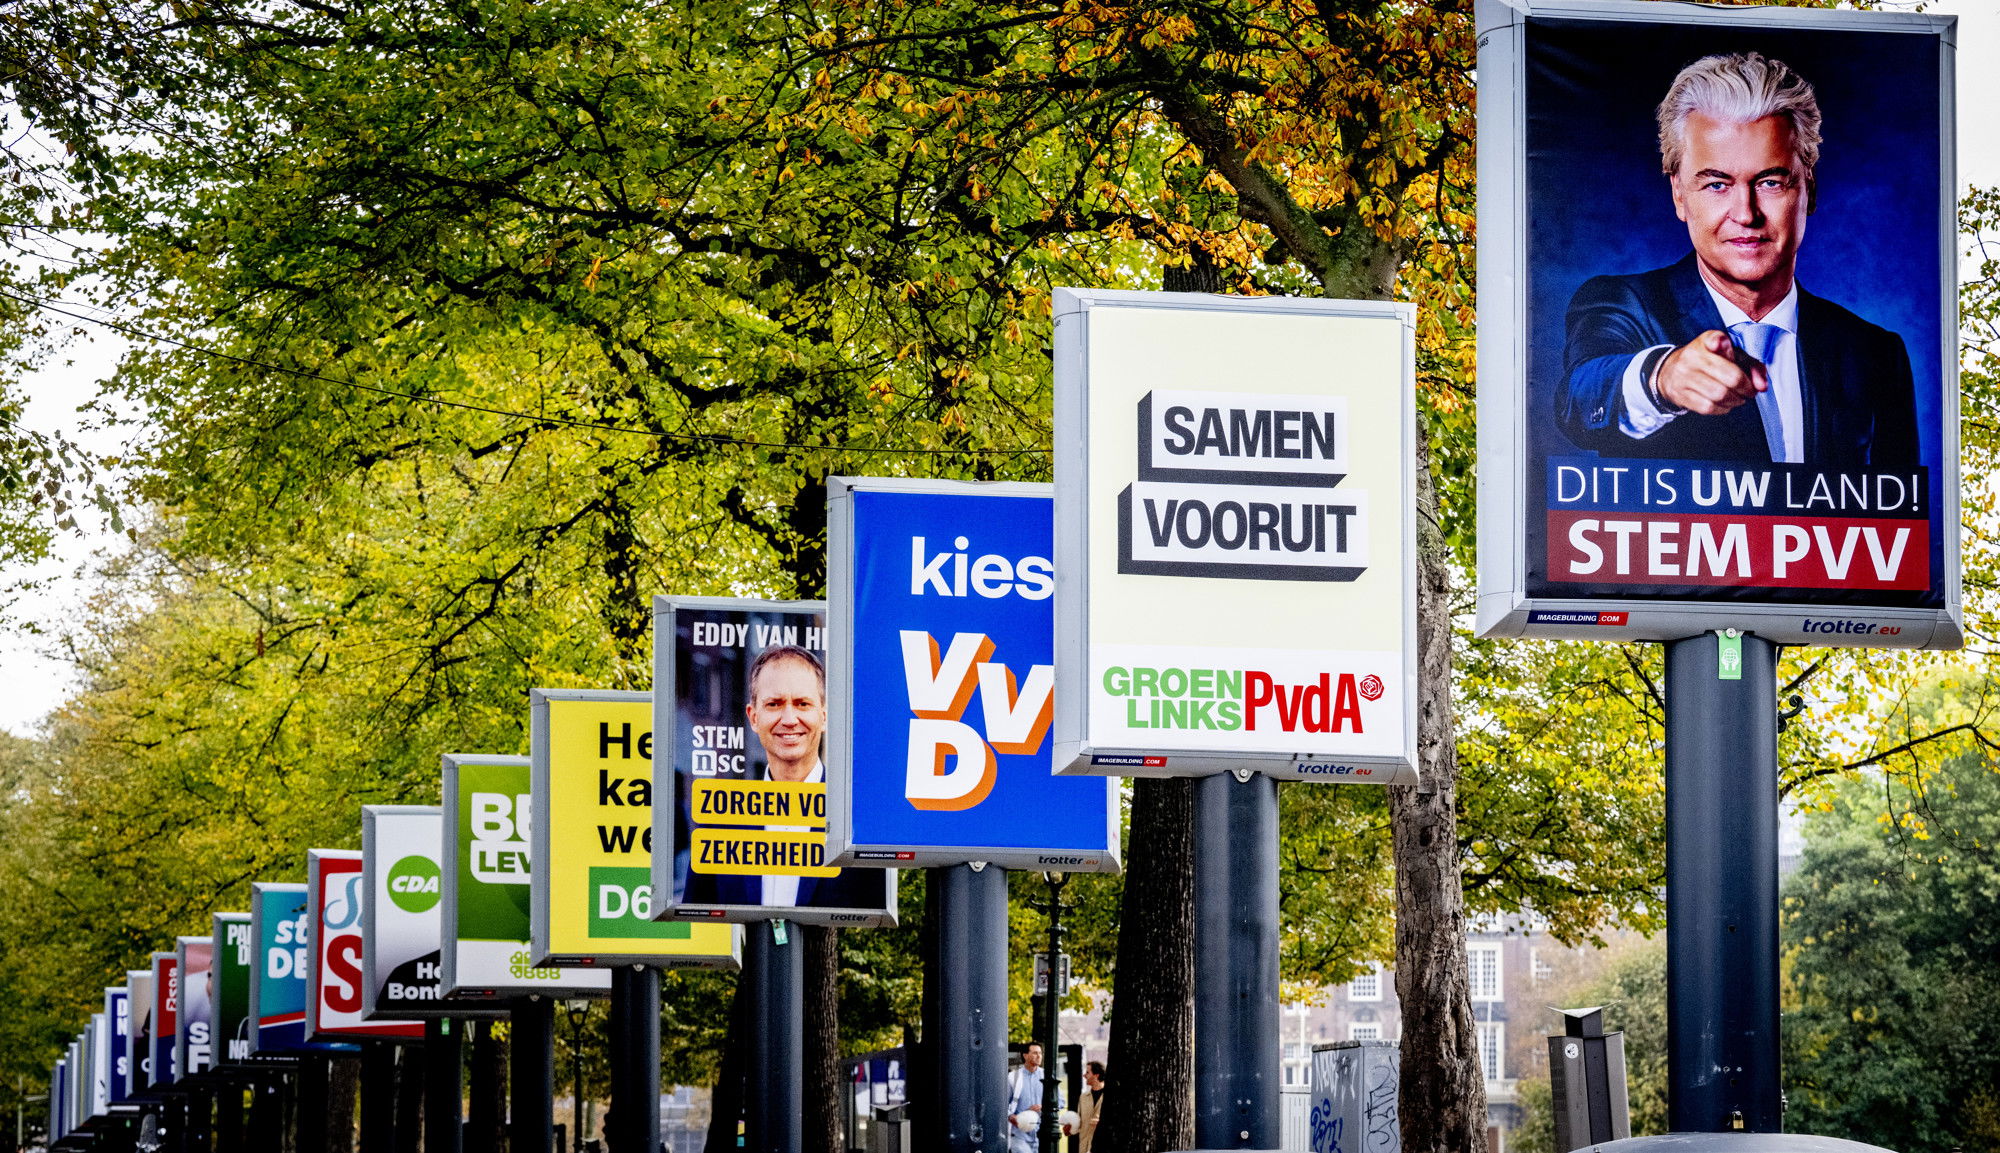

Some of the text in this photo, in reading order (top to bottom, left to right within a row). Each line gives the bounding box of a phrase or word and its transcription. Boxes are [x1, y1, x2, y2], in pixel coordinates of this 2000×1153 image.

[1163, 406, 1335, 460] SAMEN
[1556, 466, 1919, 511] DIT IS UW LAND!
[1143, 498, 1357, 554] VOORUIT
[1568, 519, 1911, 581] STEM PVV
[911, 536, 1054, 600] kies
[693, 622, 749, 647] EDDY
[756, 625, 797, 649] VAN
[1802, 618, 1901, 635] trotter.eu
[1102, 666, 1242, 700] GROEN
[1126, 699, 1242, 731] LINKS
[1244, 670, 1363, 734] PvdA
[692, 725, 745, 749] STEM
[692, 750, 746, 776] nsc
[1297, 763, 1372, 775] trotter.eu
[599, 769, 652, 807] ka
[700, 790, 825, 818] ZORGEN VO
[699, 840, 825, 867] ZEKERHEID
[391, 875, 439, 894] CDA
[599, 885, 652, 920] D6
